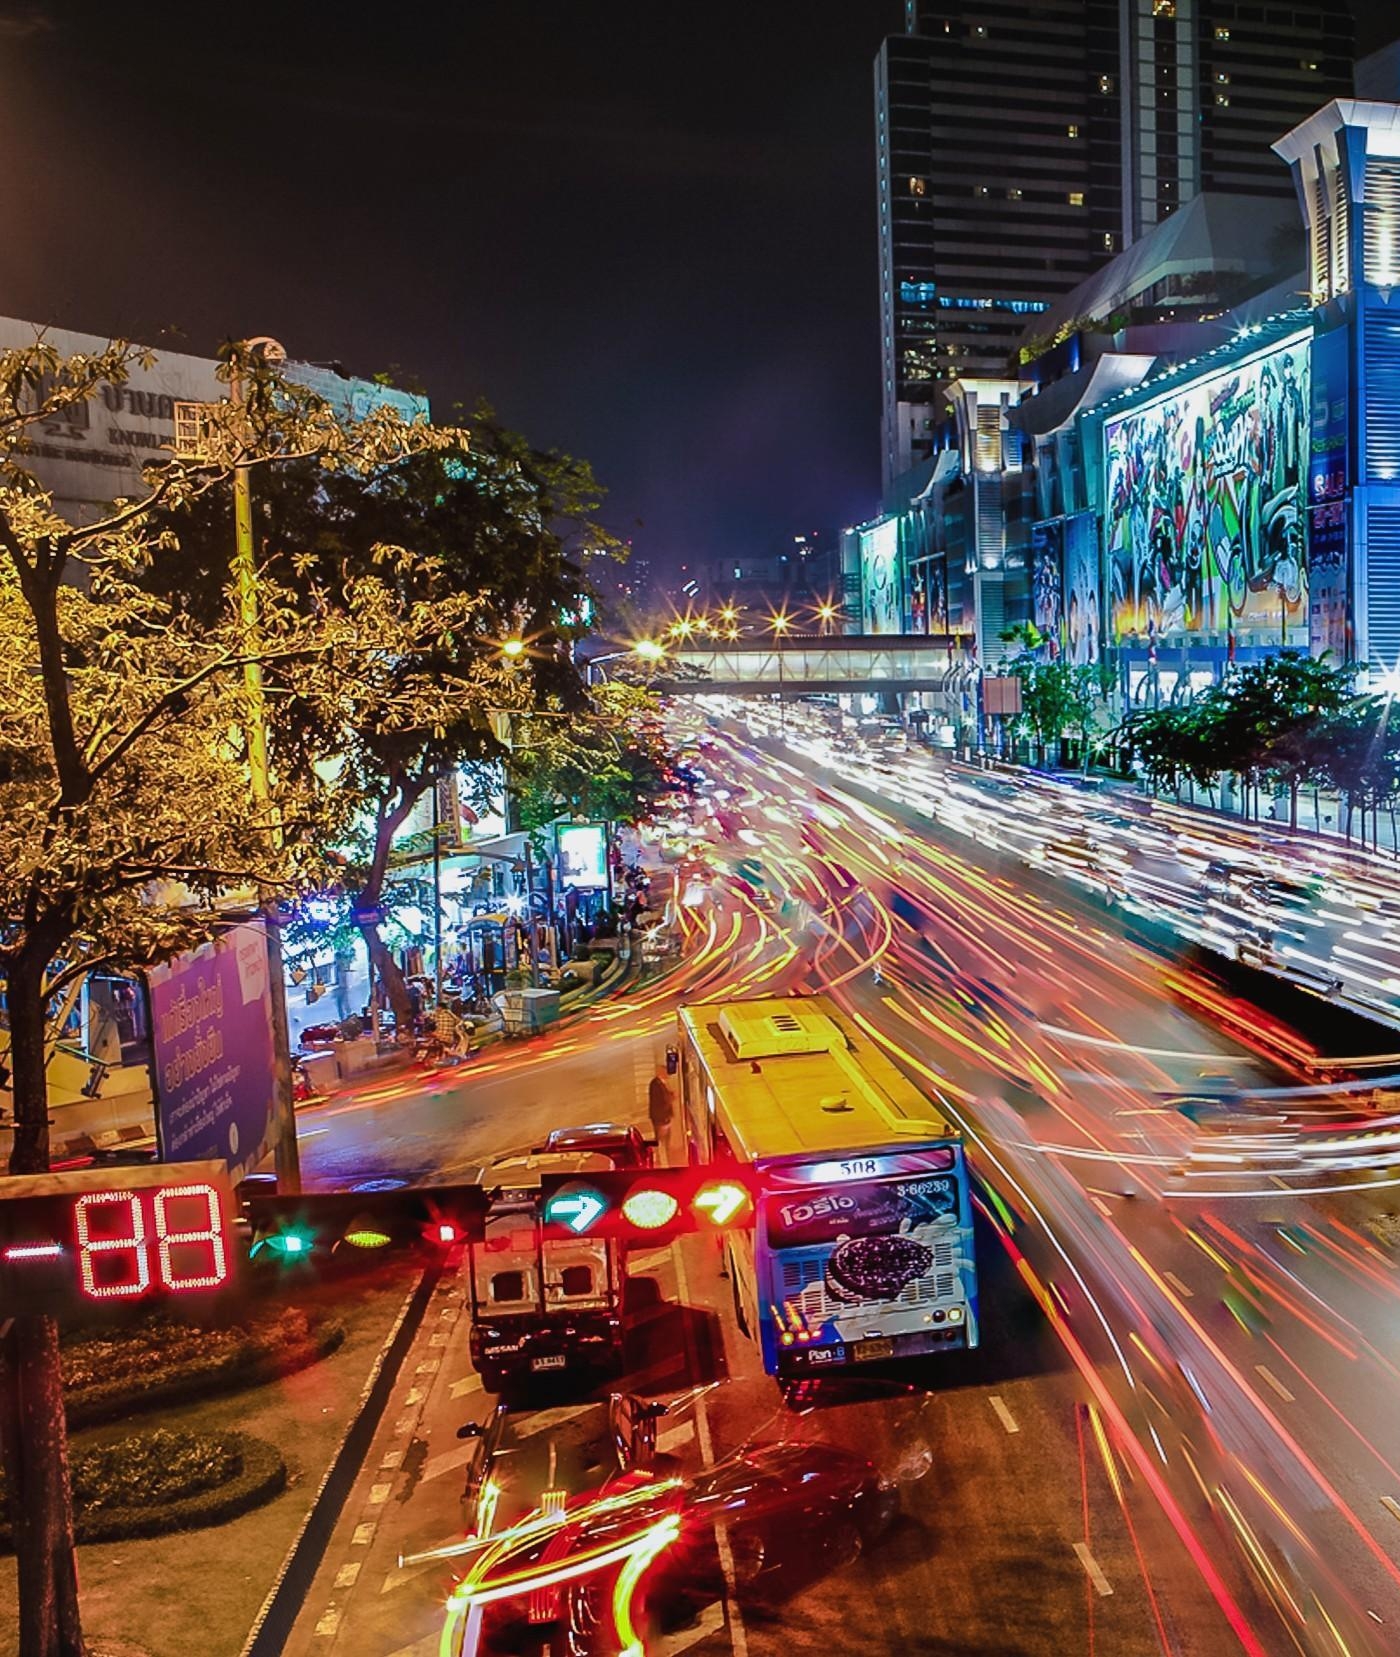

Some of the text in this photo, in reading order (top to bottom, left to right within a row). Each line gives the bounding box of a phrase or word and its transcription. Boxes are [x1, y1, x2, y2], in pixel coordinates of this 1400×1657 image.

[840, 1159, 878, 1176] 508
[780, 1195, 854, 1227] โอรีโอ
[485, 1345, 518, 1355] NISSAN
